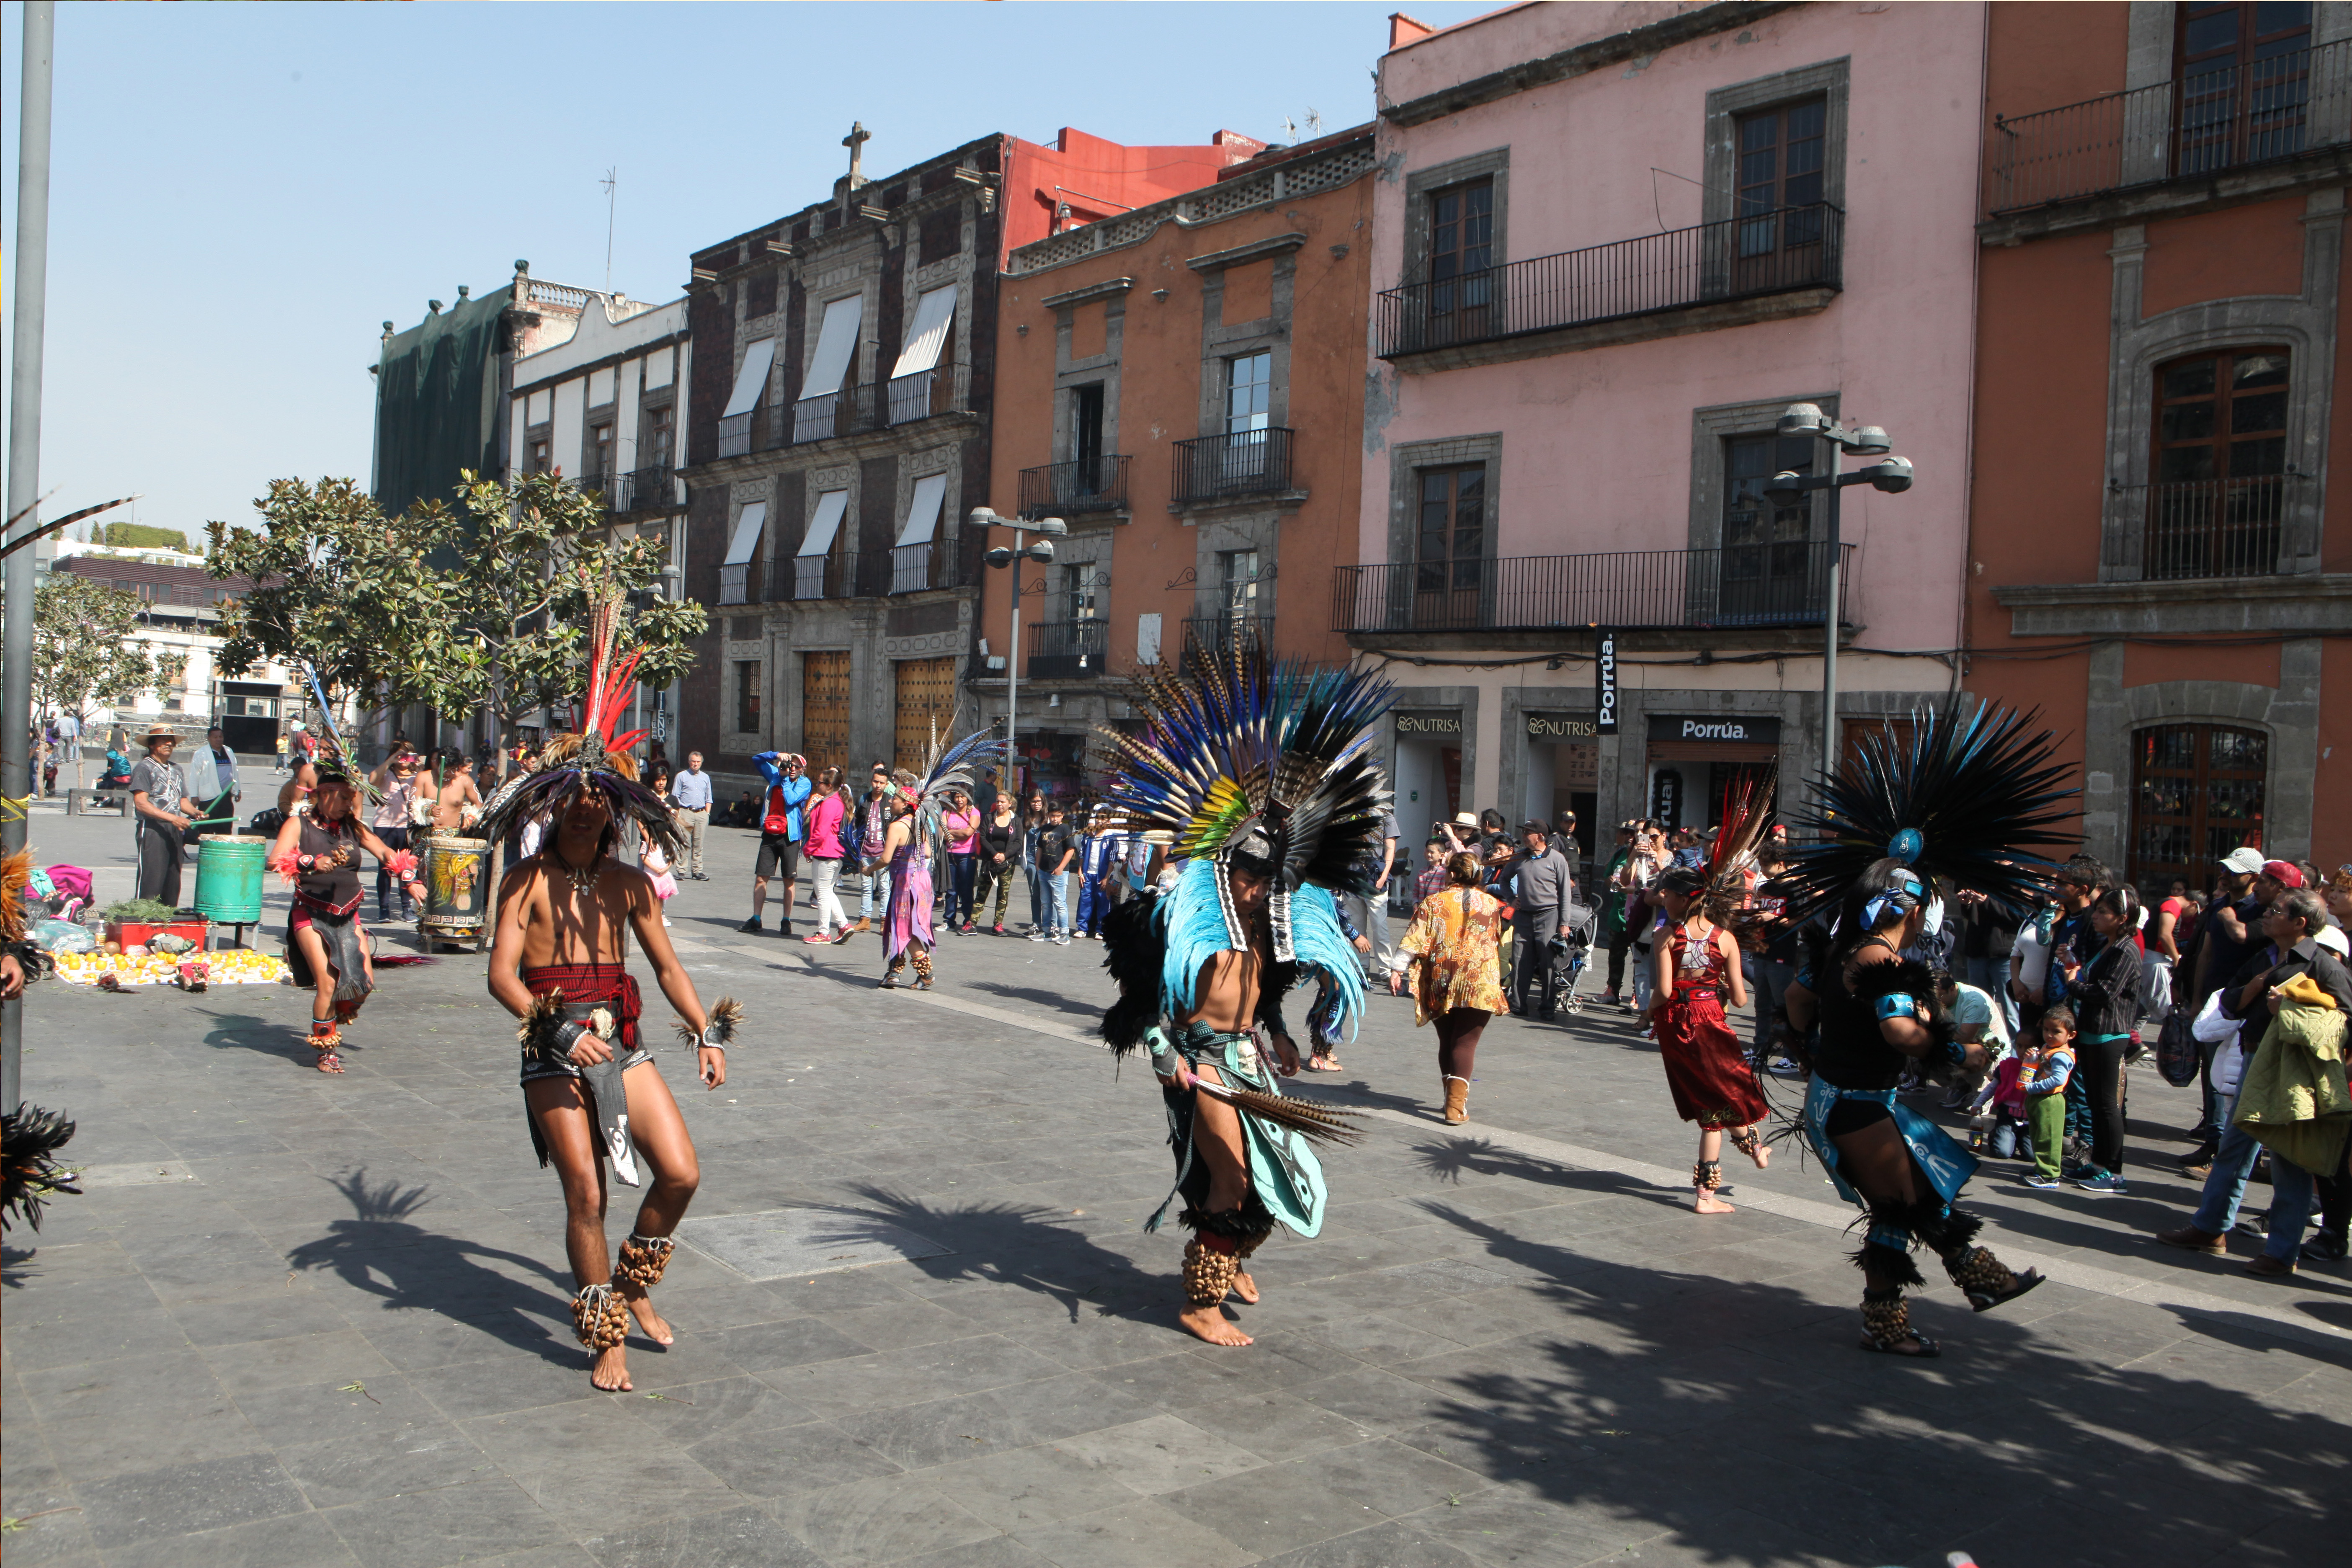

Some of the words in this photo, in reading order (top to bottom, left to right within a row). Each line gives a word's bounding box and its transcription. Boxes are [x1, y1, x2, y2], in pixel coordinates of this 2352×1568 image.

[1600, 640, 1614, 724] Porrúa
[1414, 719, 1461, 732] NUTRISA
[1547, 722, 1598, 736] NUTRISA
[1682, 720, 1744, 739] Porrúa
